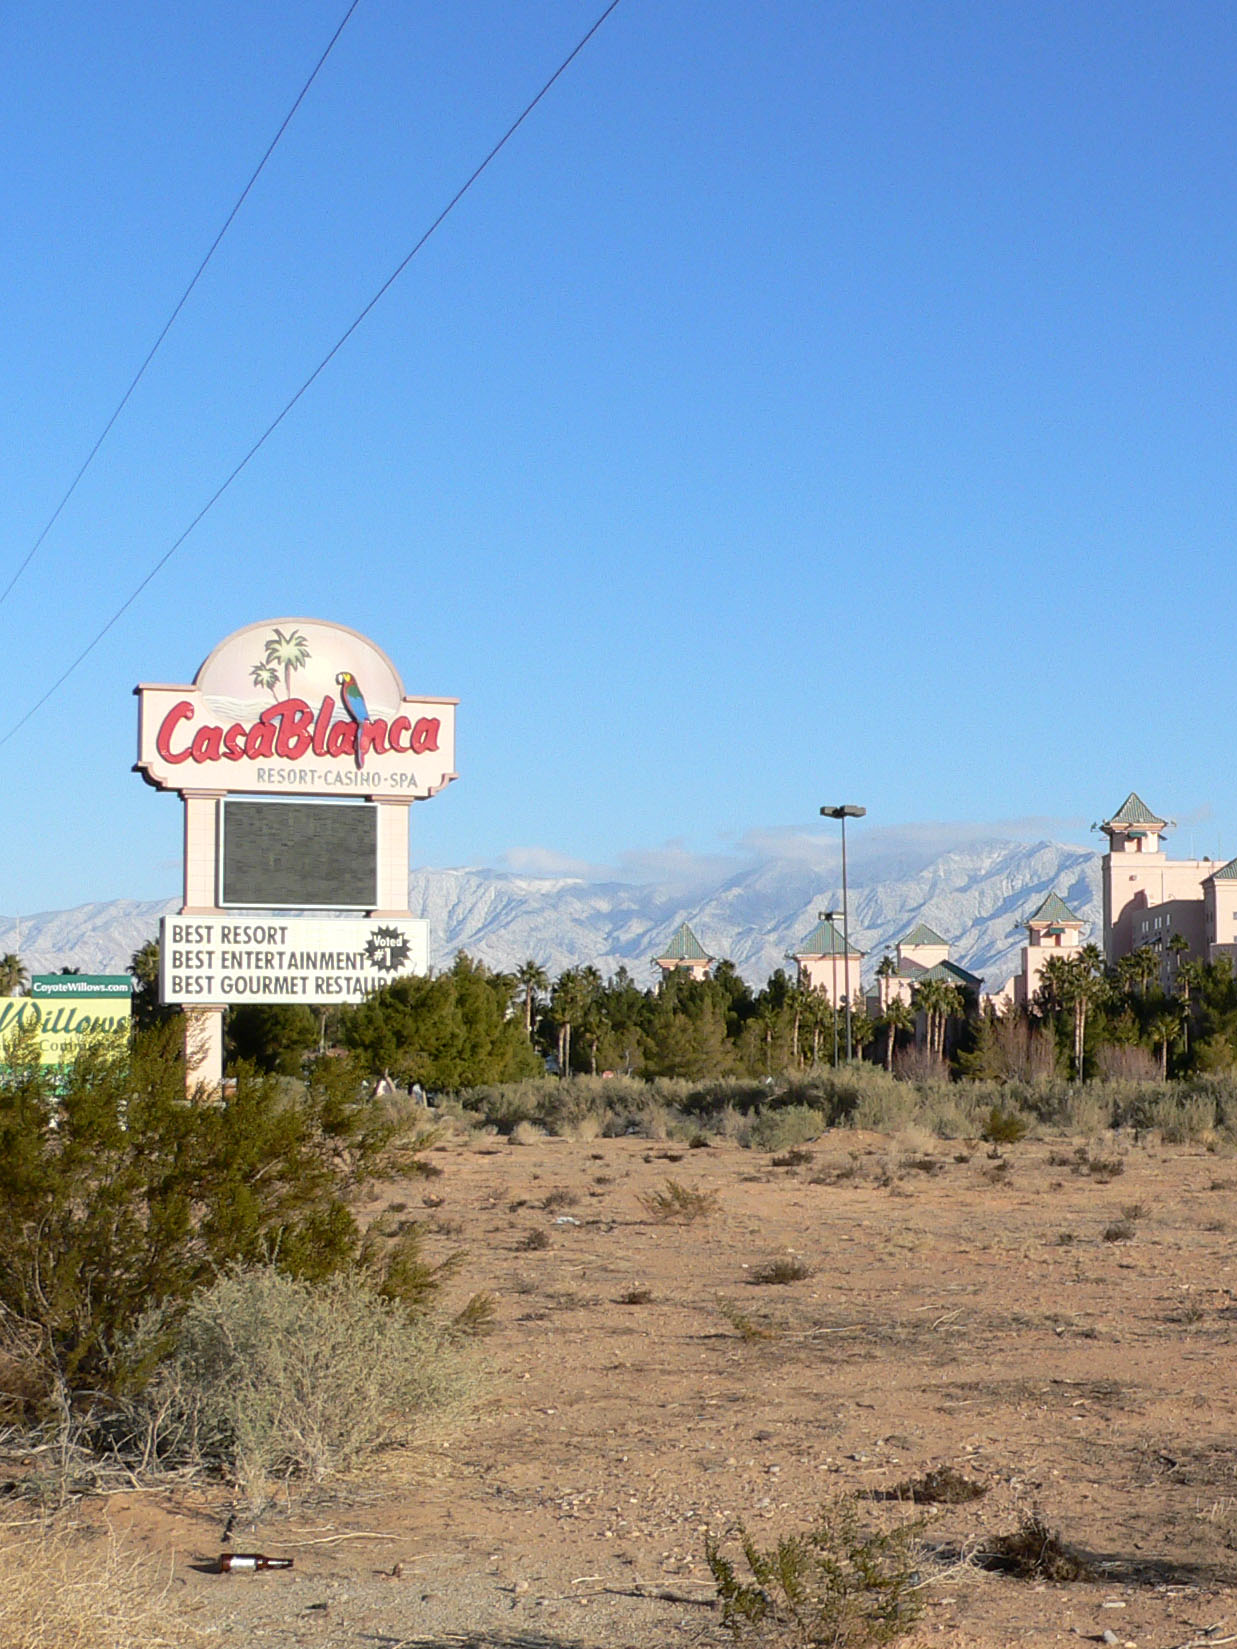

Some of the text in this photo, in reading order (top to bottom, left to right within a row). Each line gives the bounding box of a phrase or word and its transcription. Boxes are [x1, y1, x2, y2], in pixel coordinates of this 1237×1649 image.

[156, 694, 441, 764] CasaBlanca
[172, 924, 288, 945] BEST RESORT
[373, 934, 403, 947] Voted
[172, 950, 366, 971] BEST ENTERTAINMENT
[373, 947, 391, 967] #1
[33, 982, 129, 994] CoyoteWillows.com
[171, 975, 215, 994] BEST
[220, 975, 309, 995] GOURMET
